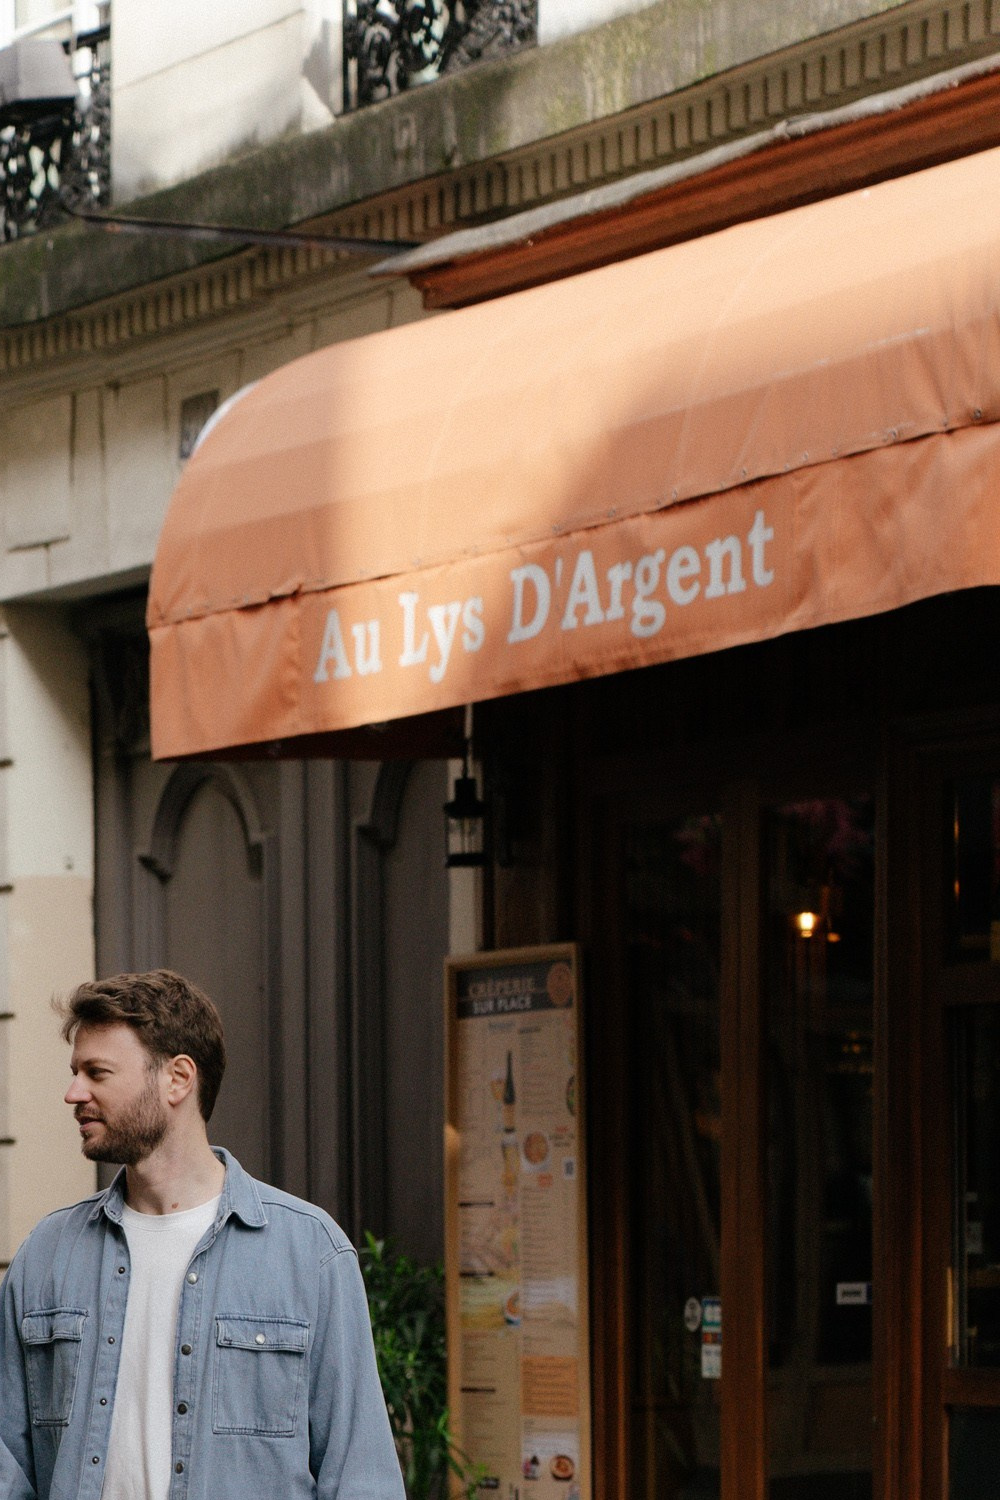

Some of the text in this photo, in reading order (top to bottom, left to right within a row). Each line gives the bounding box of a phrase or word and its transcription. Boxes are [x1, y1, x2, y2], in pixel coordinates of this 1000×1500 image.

[313, 509, 776, 684] Au Lys D'Argent
[472, 993, 532, 1015] SUR PLACE
